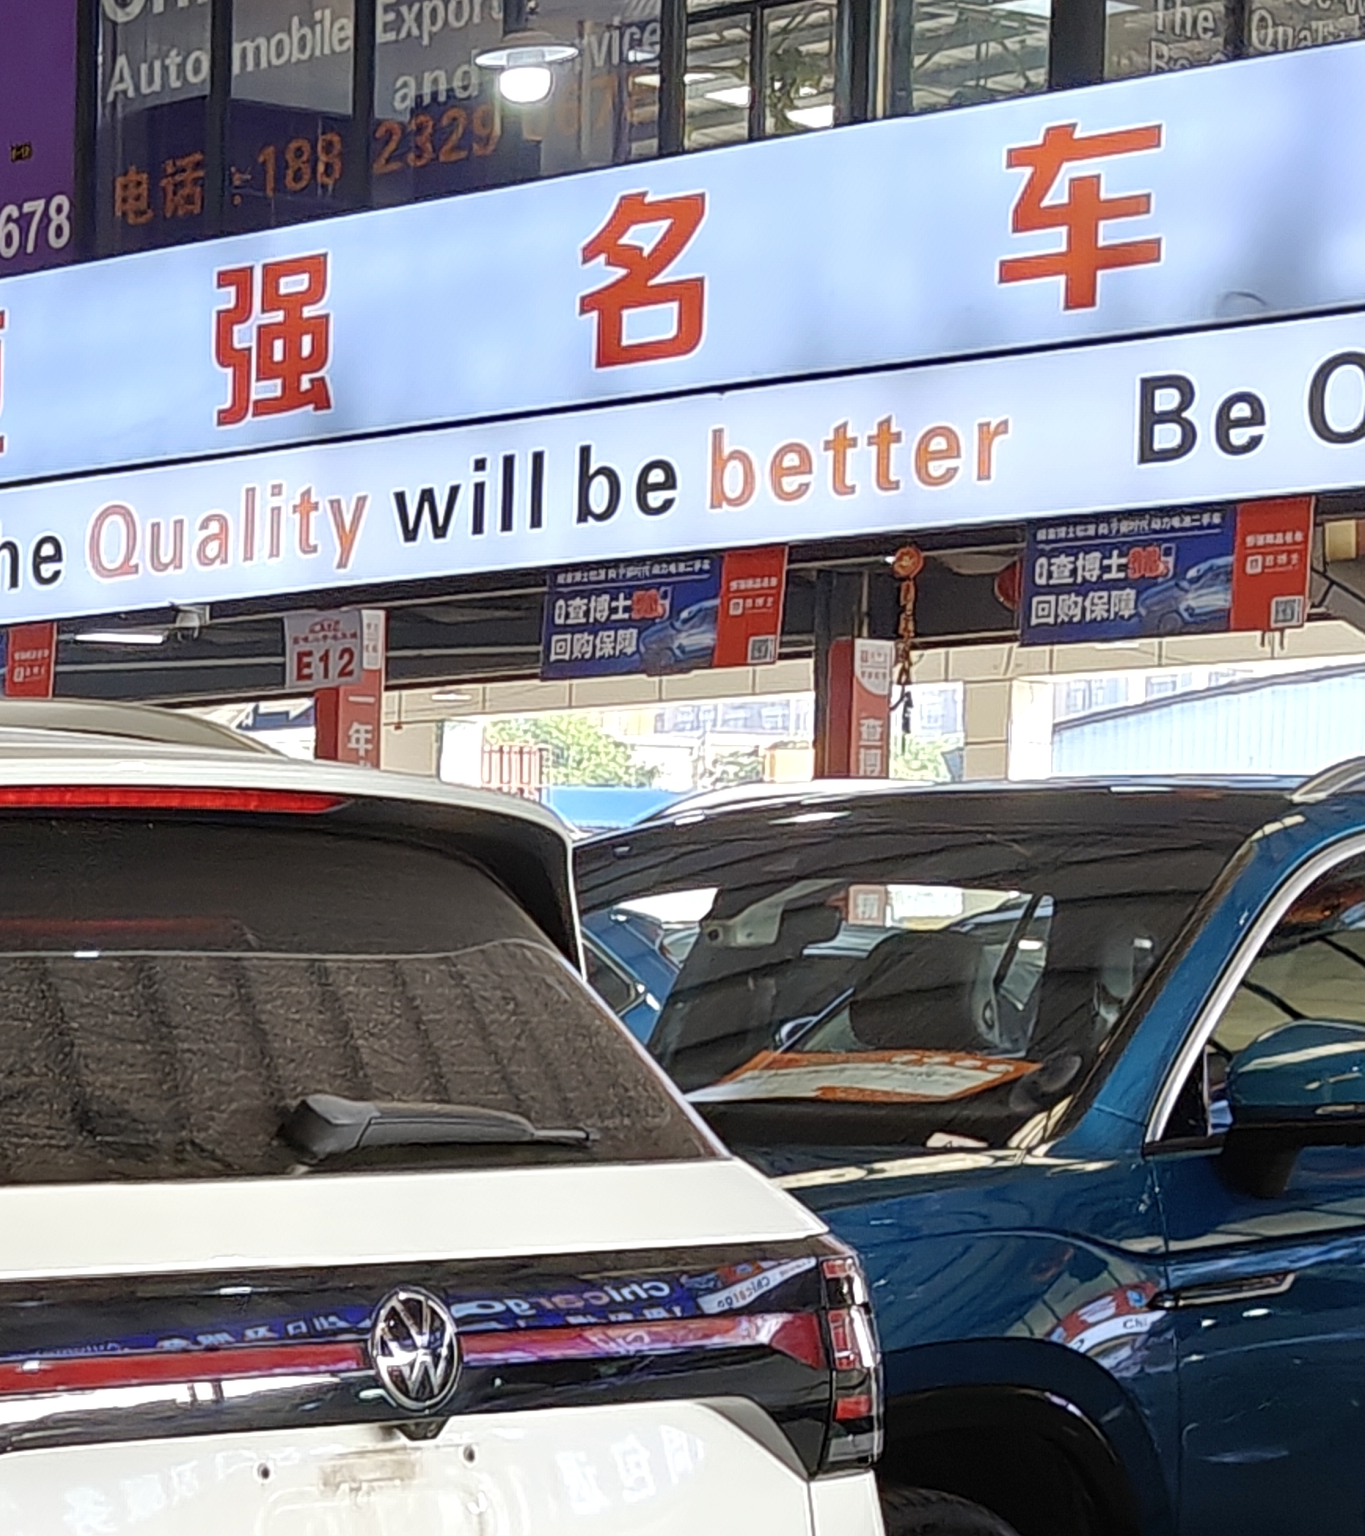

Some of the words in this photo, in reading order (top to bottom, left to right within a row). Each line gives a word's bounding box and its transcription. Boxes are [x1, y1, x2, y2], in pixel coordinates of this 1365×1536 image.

[106, 49, 210, 103] Auto
[232, 8, 352, 75] mobile
[113, 151, 206, 226] 电话
[372, 103, 503, 176] 2329
[1137, 373, 1267, 465] Be
[87, 484, 368, 580] Quality
[394, 450, 545, 543] will
[576, 444, 678, 524] be
[708, 413, 1010, 510] better
[549, 627, 638, 662] 回购保障
[1029, 589, 1137, 627] 回购保障
[295, 646, 356, 682] E12
